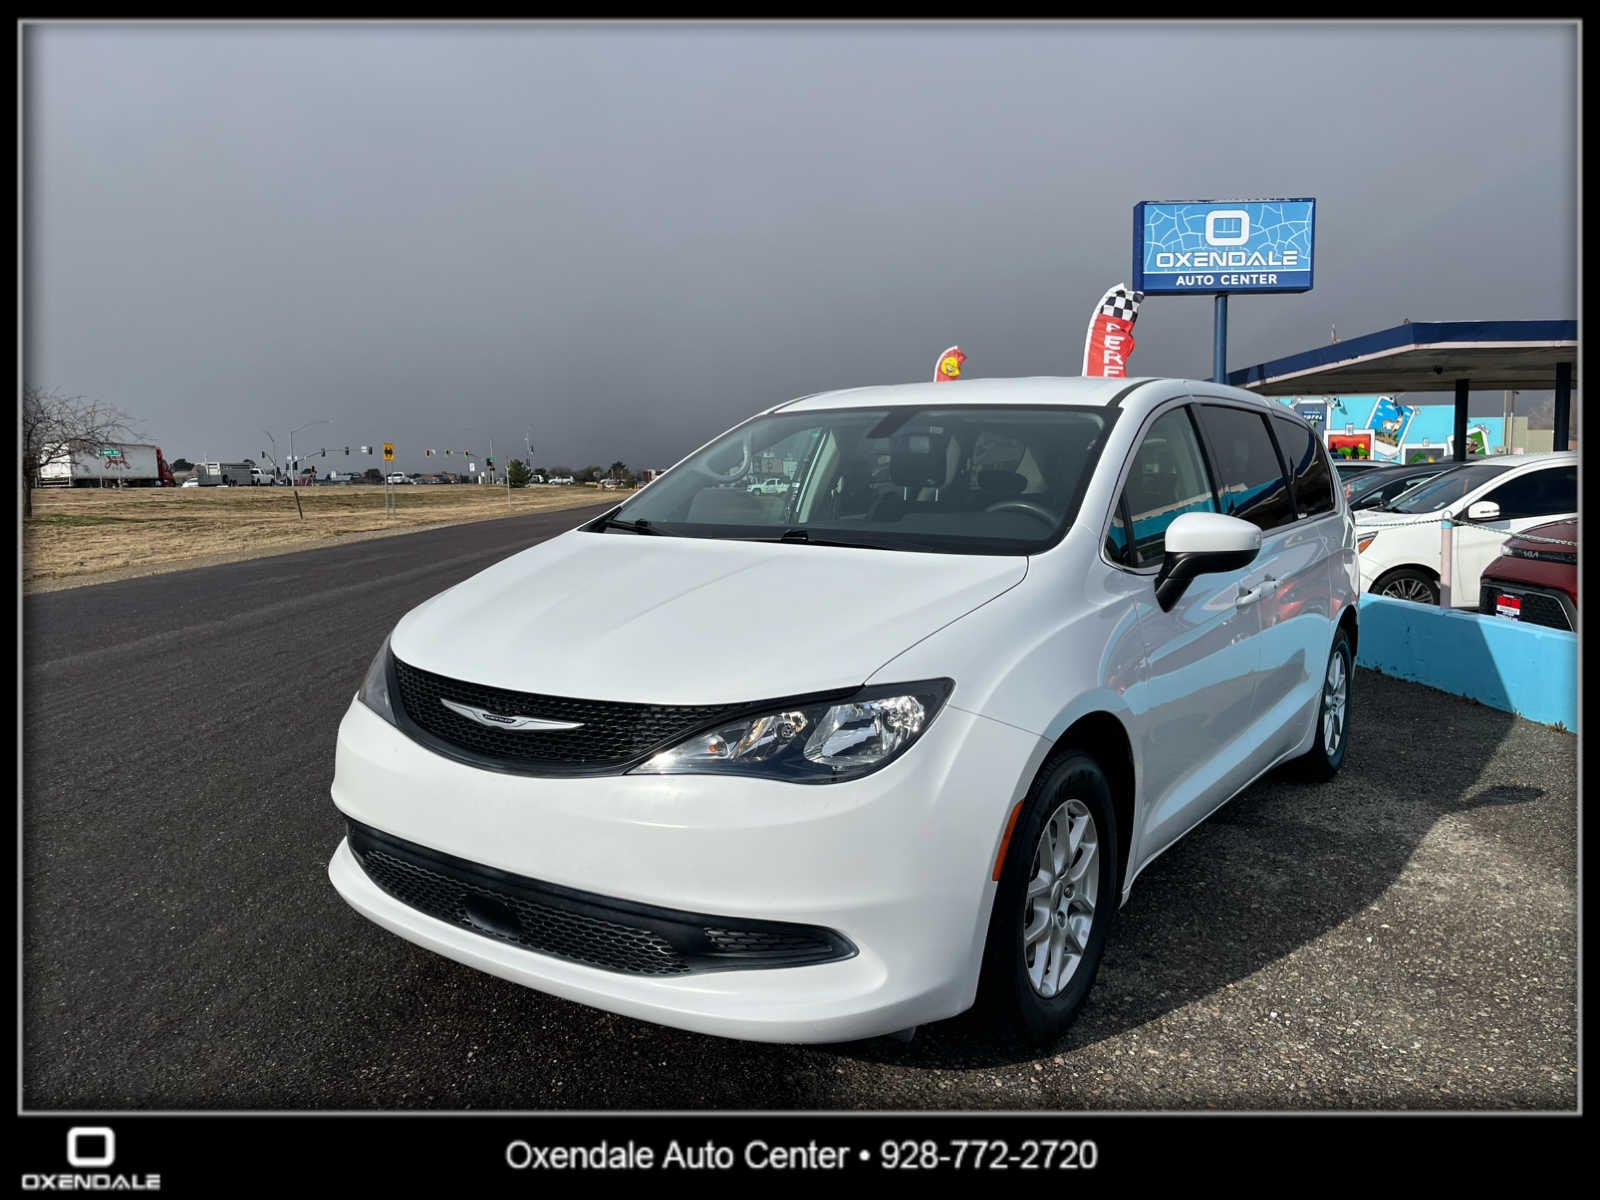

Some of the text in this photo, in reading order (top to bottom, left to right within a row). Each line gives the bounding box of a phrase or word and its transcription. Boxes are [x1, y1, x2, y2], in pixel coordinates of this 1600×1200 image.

[1156, 250, 1298, 268] OXENDALE
[1176, 273, 1278, 286] AUTO CENTER
